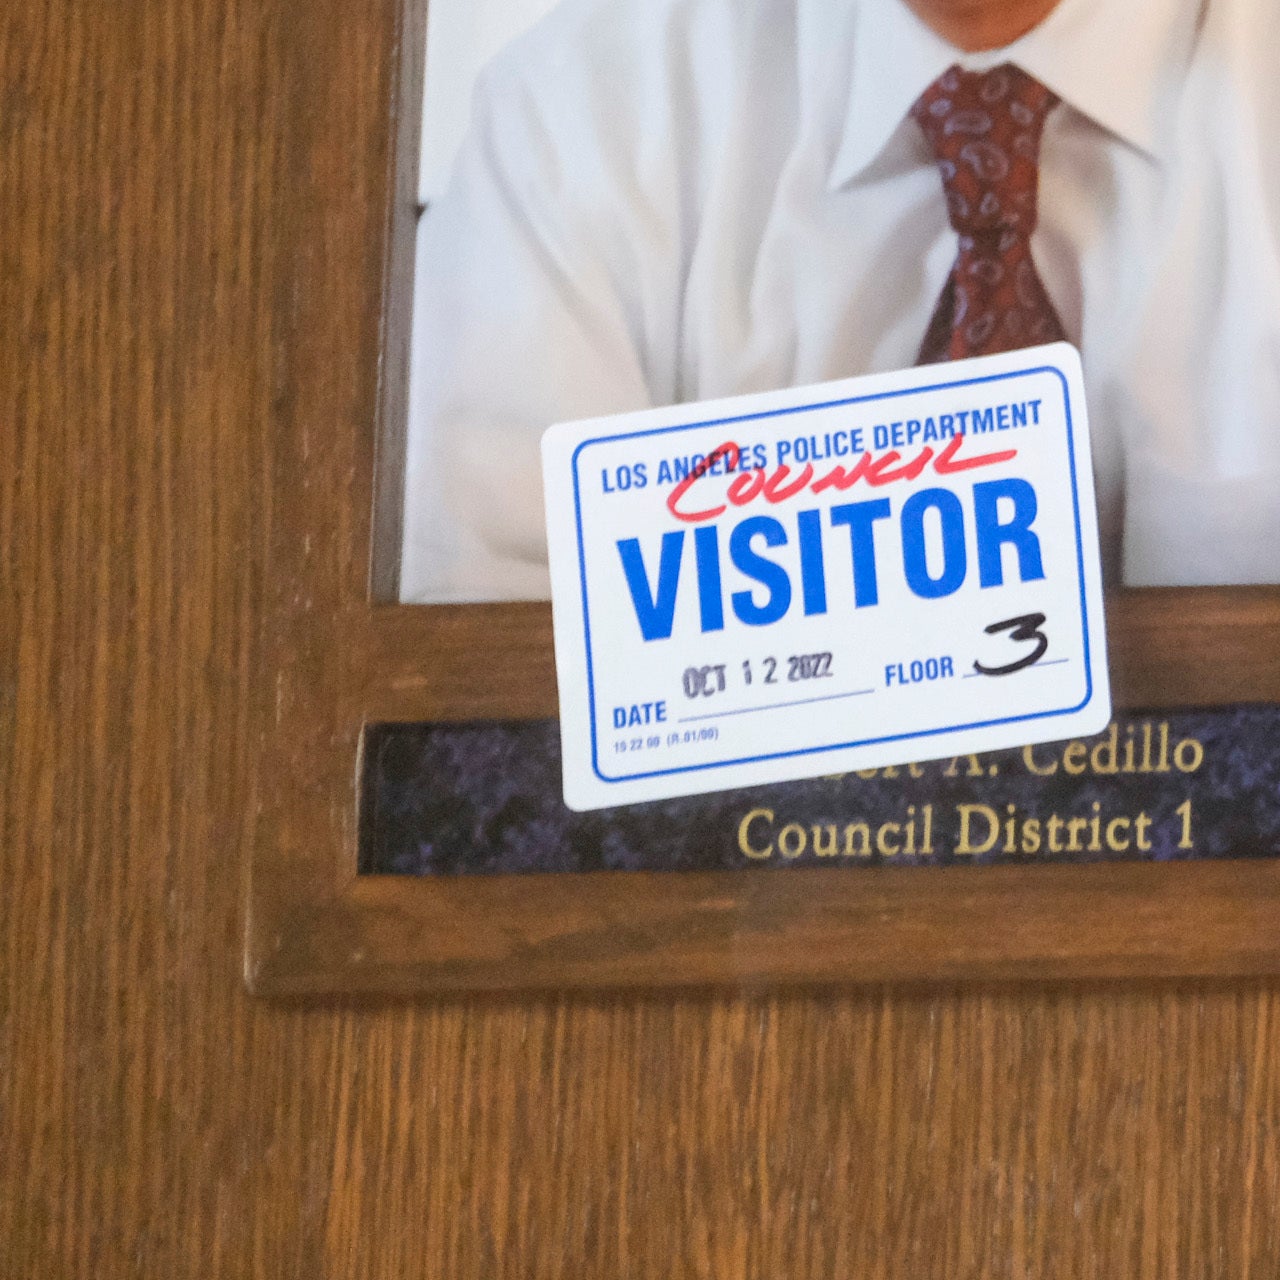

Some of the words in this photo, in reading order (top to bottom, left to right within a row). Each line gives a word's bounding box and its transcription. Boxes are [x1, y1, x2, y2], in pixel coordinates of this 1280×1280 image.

[602, 461, 648, 493] LOS
[657, 443, 767, 485] ANGELES
[778, 429, 865, 465] POLICE
[874, 400, 1042, 451] DEPARTMENT
[616, 476, 1046, 642] VISITOR
[973, 612, 1048, 678] 3
[613, 700, 667, 729] DATE
[682, 663, 727, 700] OCT
[787, 652, 833, 683] 2022
[885, 656, 954, 687] FLOOR
[1022, 722, 1204, 777] Cedillo
[737, 803, 934, 859] Council
[954, 801, 1152, 855] District
[1175, 799, 1194, 850] 1
